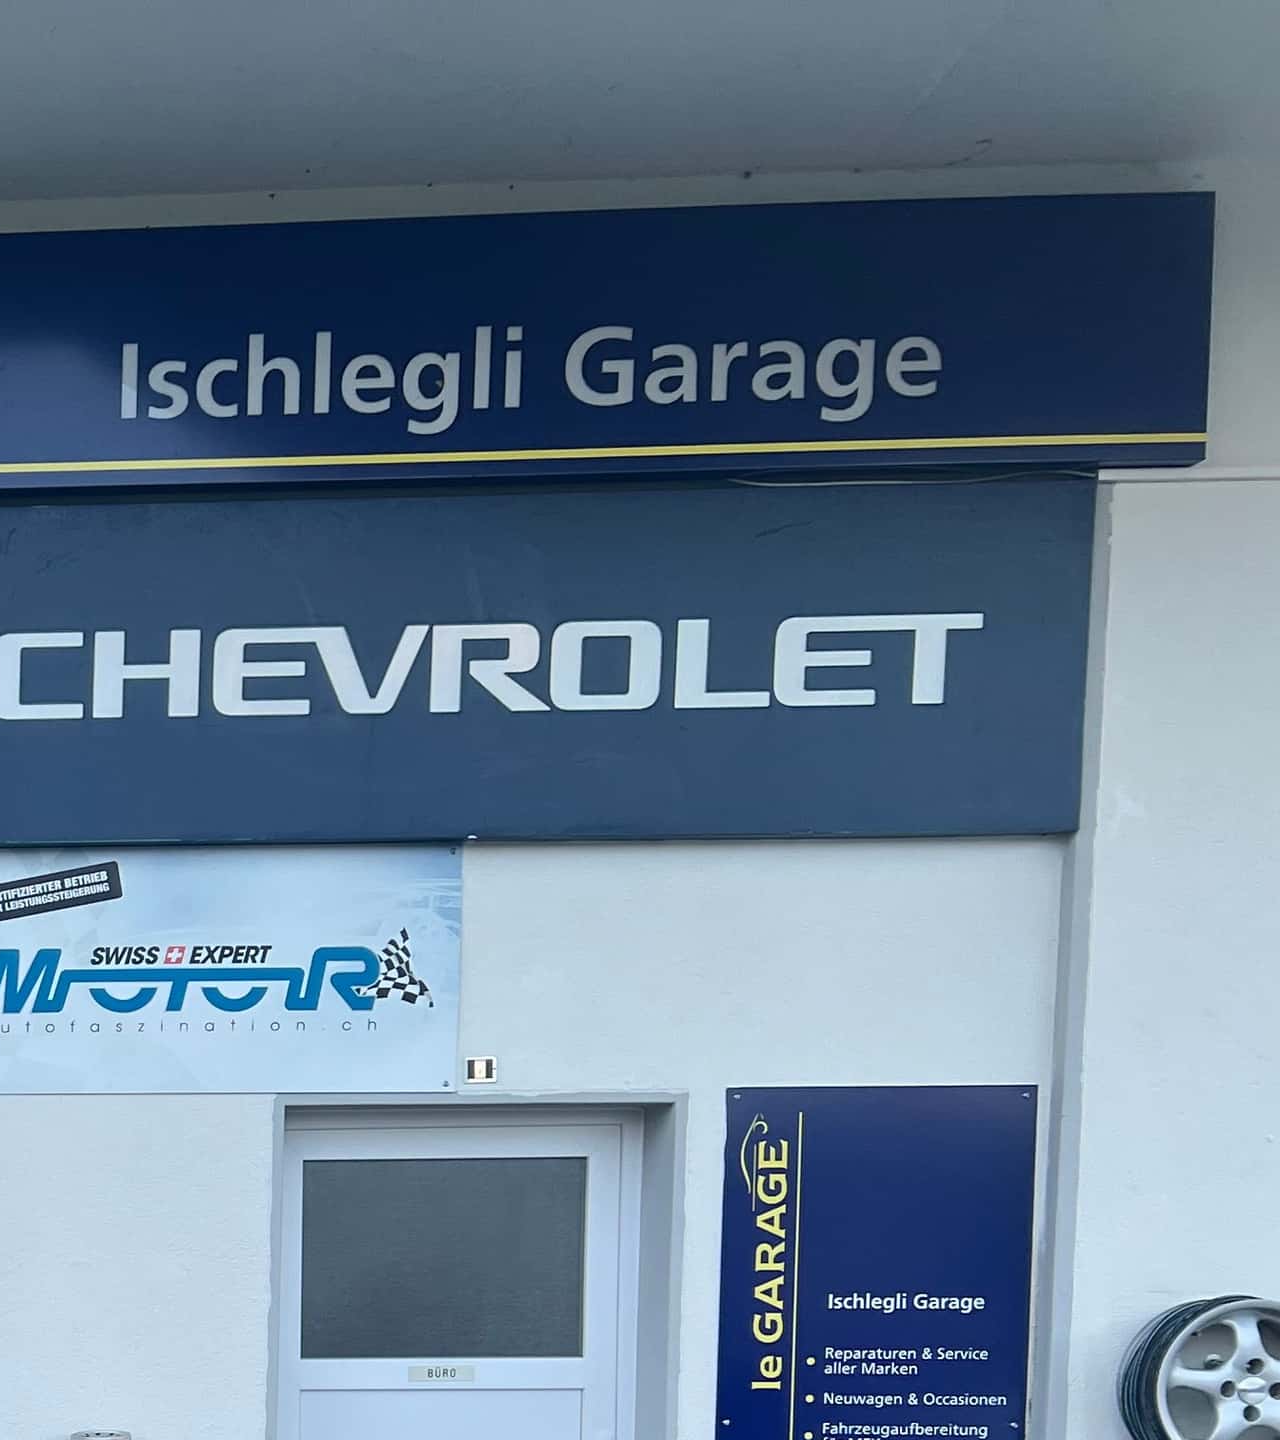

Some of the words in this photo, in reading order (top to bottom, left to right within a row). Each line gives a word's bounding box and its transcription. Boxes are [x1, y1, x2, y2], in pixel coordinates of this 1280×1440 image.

[120, 326, 524, 434] Ischlegli
[563, 324, 944, 424] Garage
[64, 870, 108, 889] BETRIEB
[4, 882, 110, 912] LEISTUNGSSTEIGERUNG
[90, 945, 160, 966] SWISS
[189, 945, 272, 965] EXPERT
[752, 1139, 789, 1344] GARAGE
[828, 1293, 907, 1314] Ischlegli
[913, 1294, 986, 1313] Garage
[825, 1347, 917, 1363] Reparaturen
[922, 1348, 932, 1360] &
[937, 1347, 989, 1361] Service
[427, 1367, 456, 1378] BÜRO
[751, 1355, 783, 1390] le
[824, 1362, 857, 1375] aller
[862, 1363, 918, 1375] Marken
[823, 1393, 902, 1408] Neuwagen
[908, 1394, 918, 1405] &
[923, 1394, 1007, 1406] Occasionen
[822, 1422, 988, 1438] Fahrzeugaufbereitung
